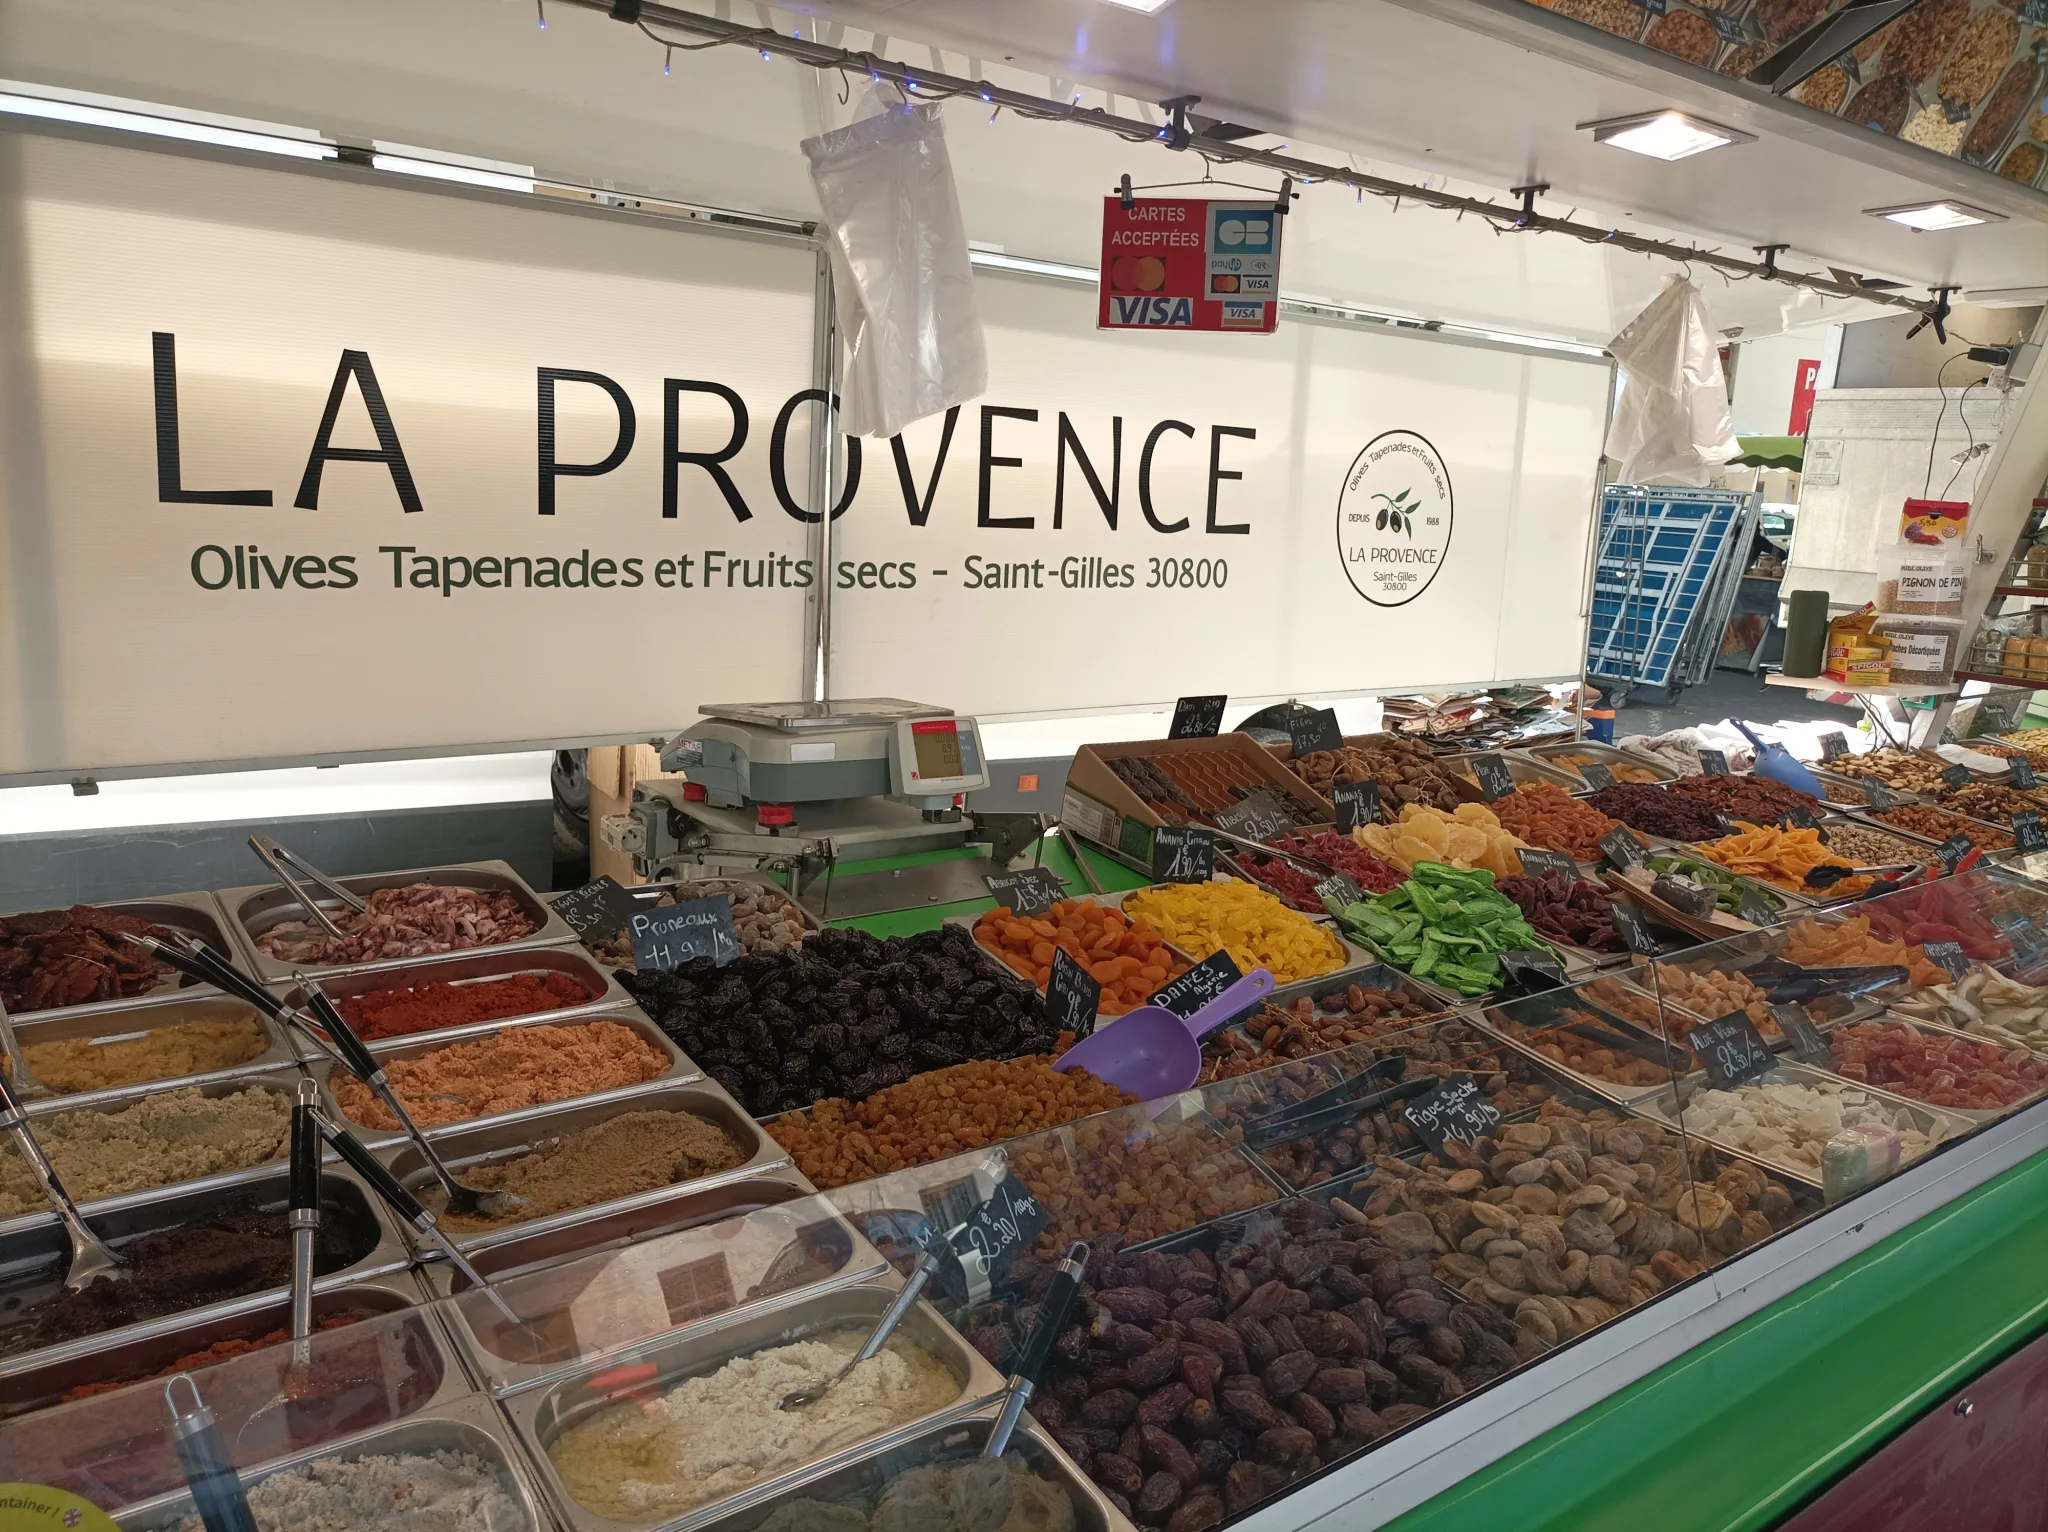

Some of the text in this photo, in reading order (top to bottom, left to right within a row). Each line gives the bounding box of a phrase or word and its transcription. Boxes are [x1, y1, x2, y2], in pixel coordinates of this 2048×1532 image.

[1128, 207, 1186, 221] CARTES
[1112, 229, 1199, 247] ACCEPTÉES
[1245, 279, 1269, 289] VISA
[1113, 297, 1192, 326] VISA
[1230, 308, 1256, 318] VISA
[152, 331, 1257, 535] LA PROVENCE
[1349, 442, 1446, 500] Olives Tapenades et Fruits secs
[1348, 513, 1370, 523] DEPUIS
[1349, 547, 1438, 563] LA PROVENCE
[191, 545, 359, 590] Olives
[379, 545, 644, 597] Tapenades
[654, 552, 693, 588] et
[703, 551, 815, 589] Fruits
[836, 559, 917, 589] secs
[963, 555, 1136, 589] Saint-Gilles
[1146, 557, 1229, 589] 30800
[1373, 571, 1418, 582] Saint-Gilles
[1382, 582, 1407, 591] 30800
[1901, 577, 1963, 588] PIGNON DE PIN
[1892, 644, 1941, 657] aches Décortiquées
[1851, 662, 1885, 670] SPIGOL
[632, 912, 718, 938] Pruneaux
[1689, 1022, 1738, 1051] ALOE VERA
[1404, 1100, 1445, 1131] Figue
